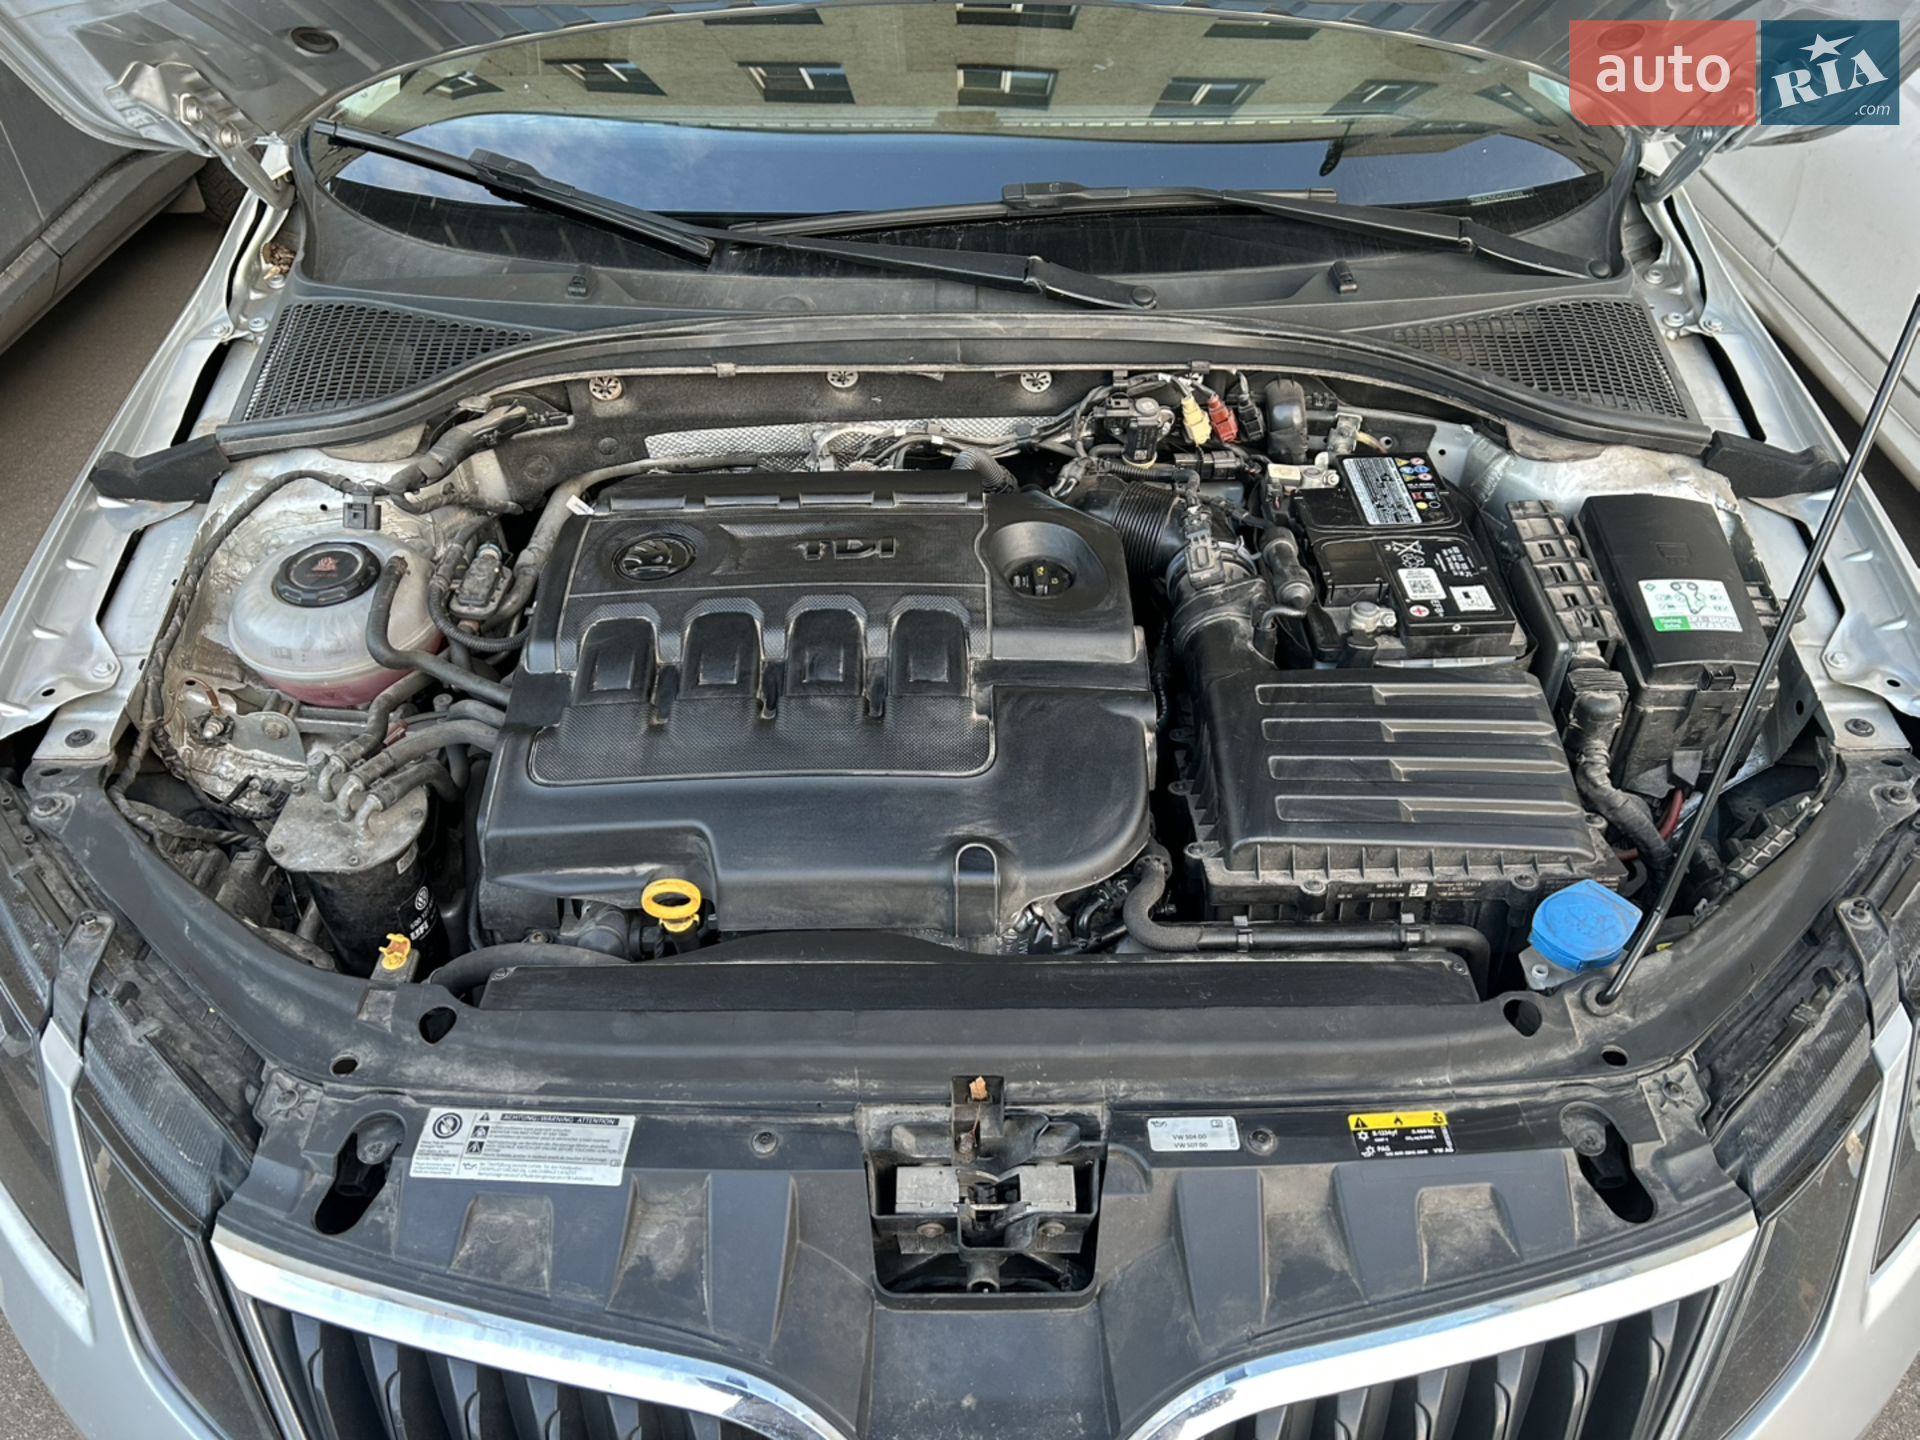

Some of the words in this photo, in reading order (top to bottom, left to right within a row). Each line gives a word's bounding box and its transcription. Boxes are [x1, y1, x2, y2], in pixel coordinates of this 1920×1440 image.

[792, 537, 896, 561] TDI
[540, 1115, 573, 1124] WARNING
[577, 1117, 615, 1126] ATTENTION
